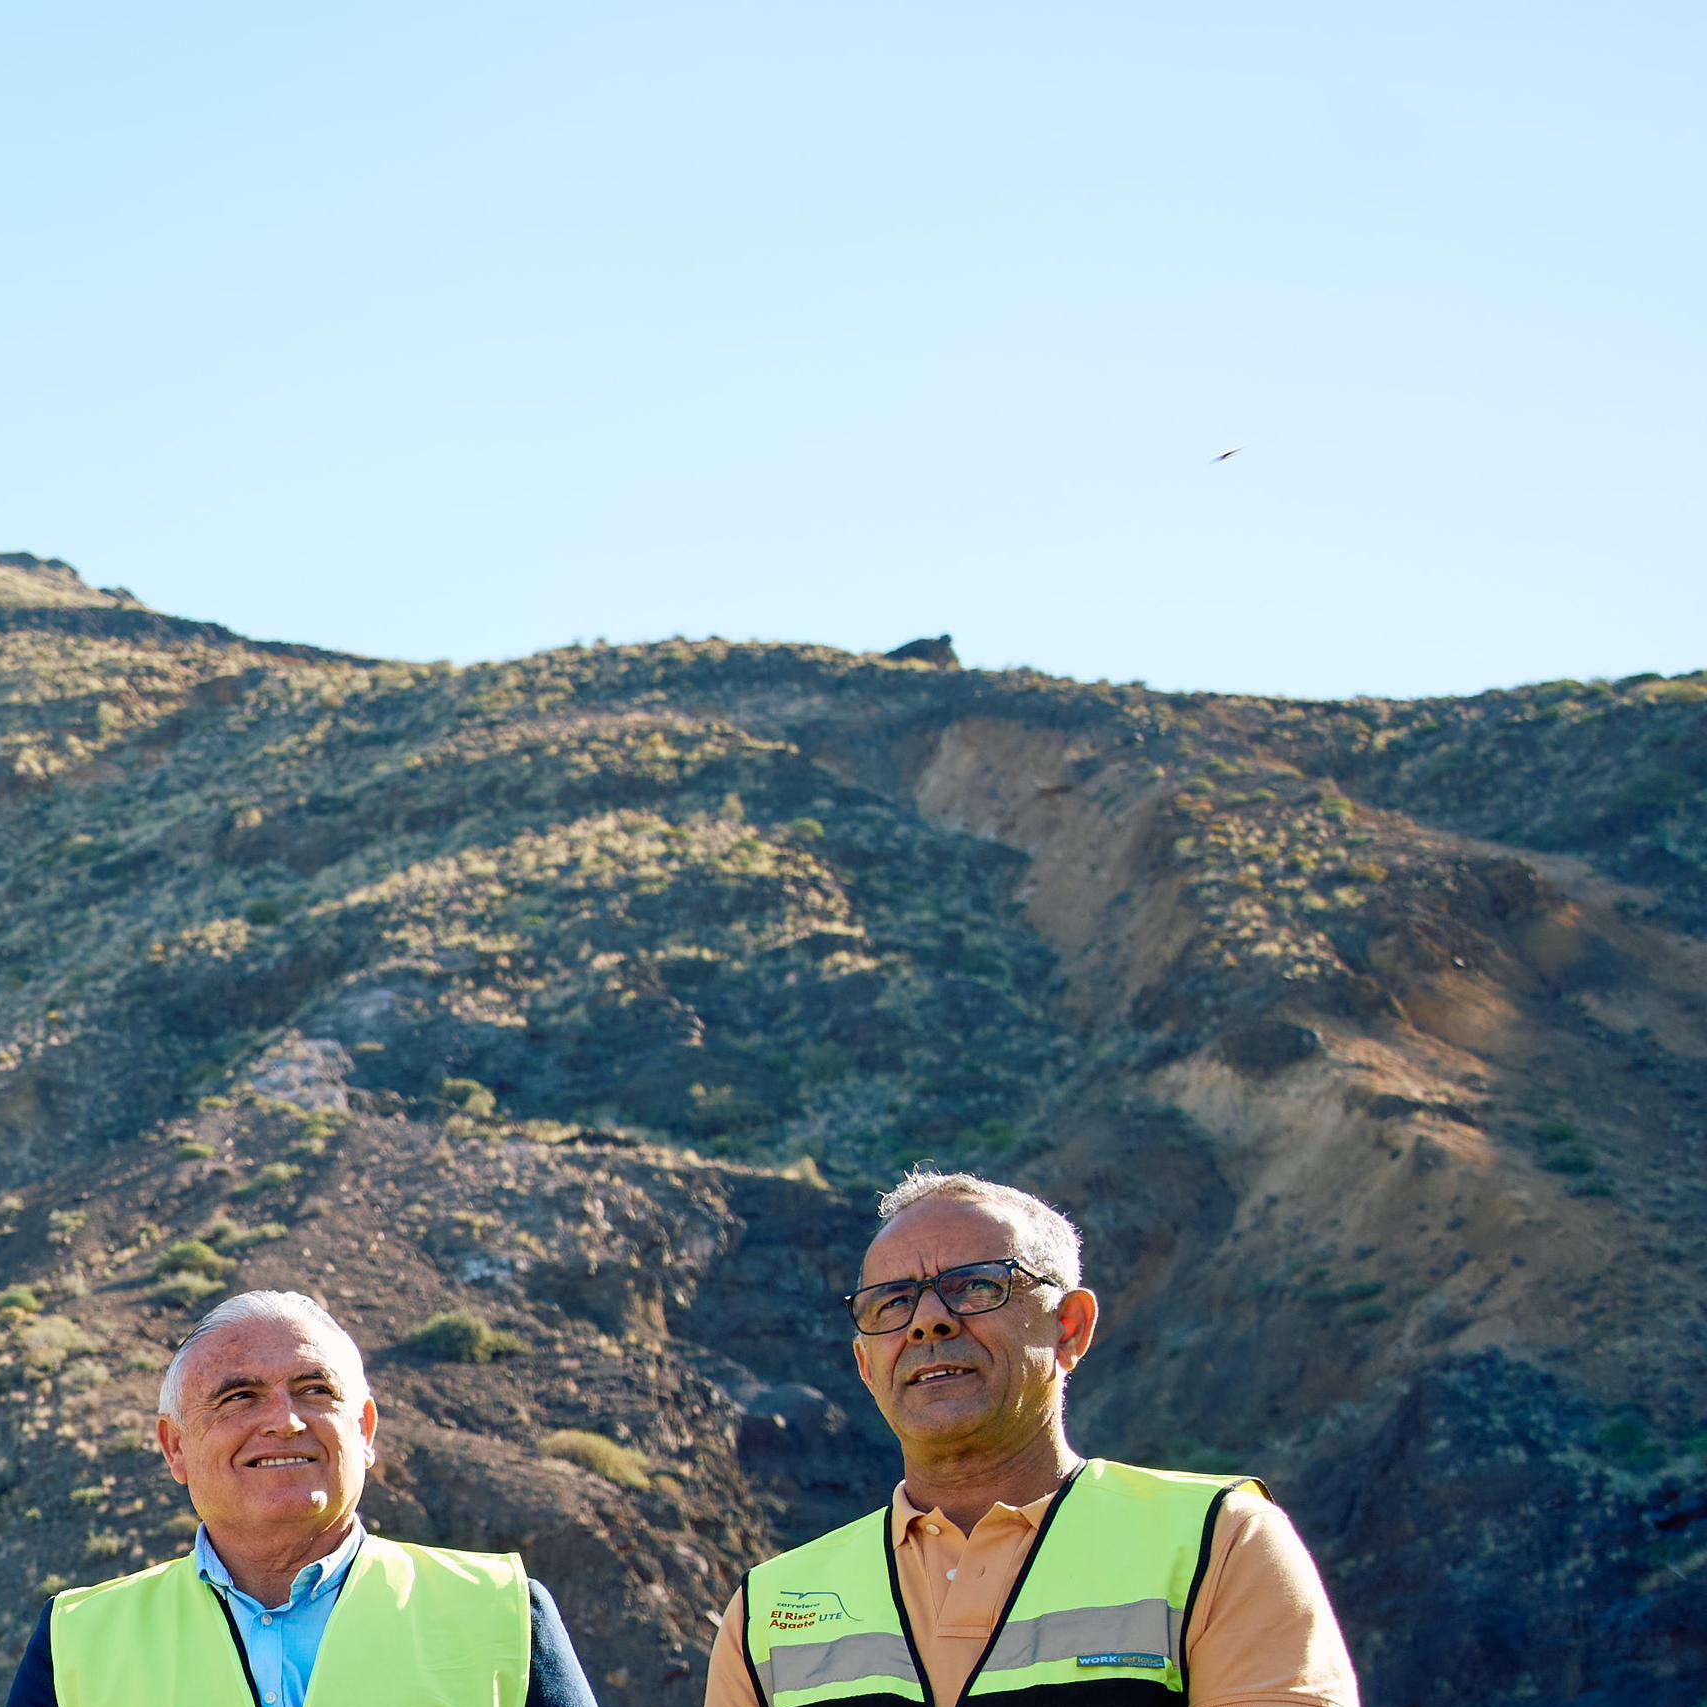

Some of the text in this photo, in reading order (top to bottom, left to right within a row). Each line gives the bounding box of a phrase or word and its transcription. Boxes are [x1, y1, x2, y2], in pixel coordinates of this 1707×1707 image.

[770, 1610, 843, 1622] El Risco UTE
[769, 1619, 815, 1630] Agaete
